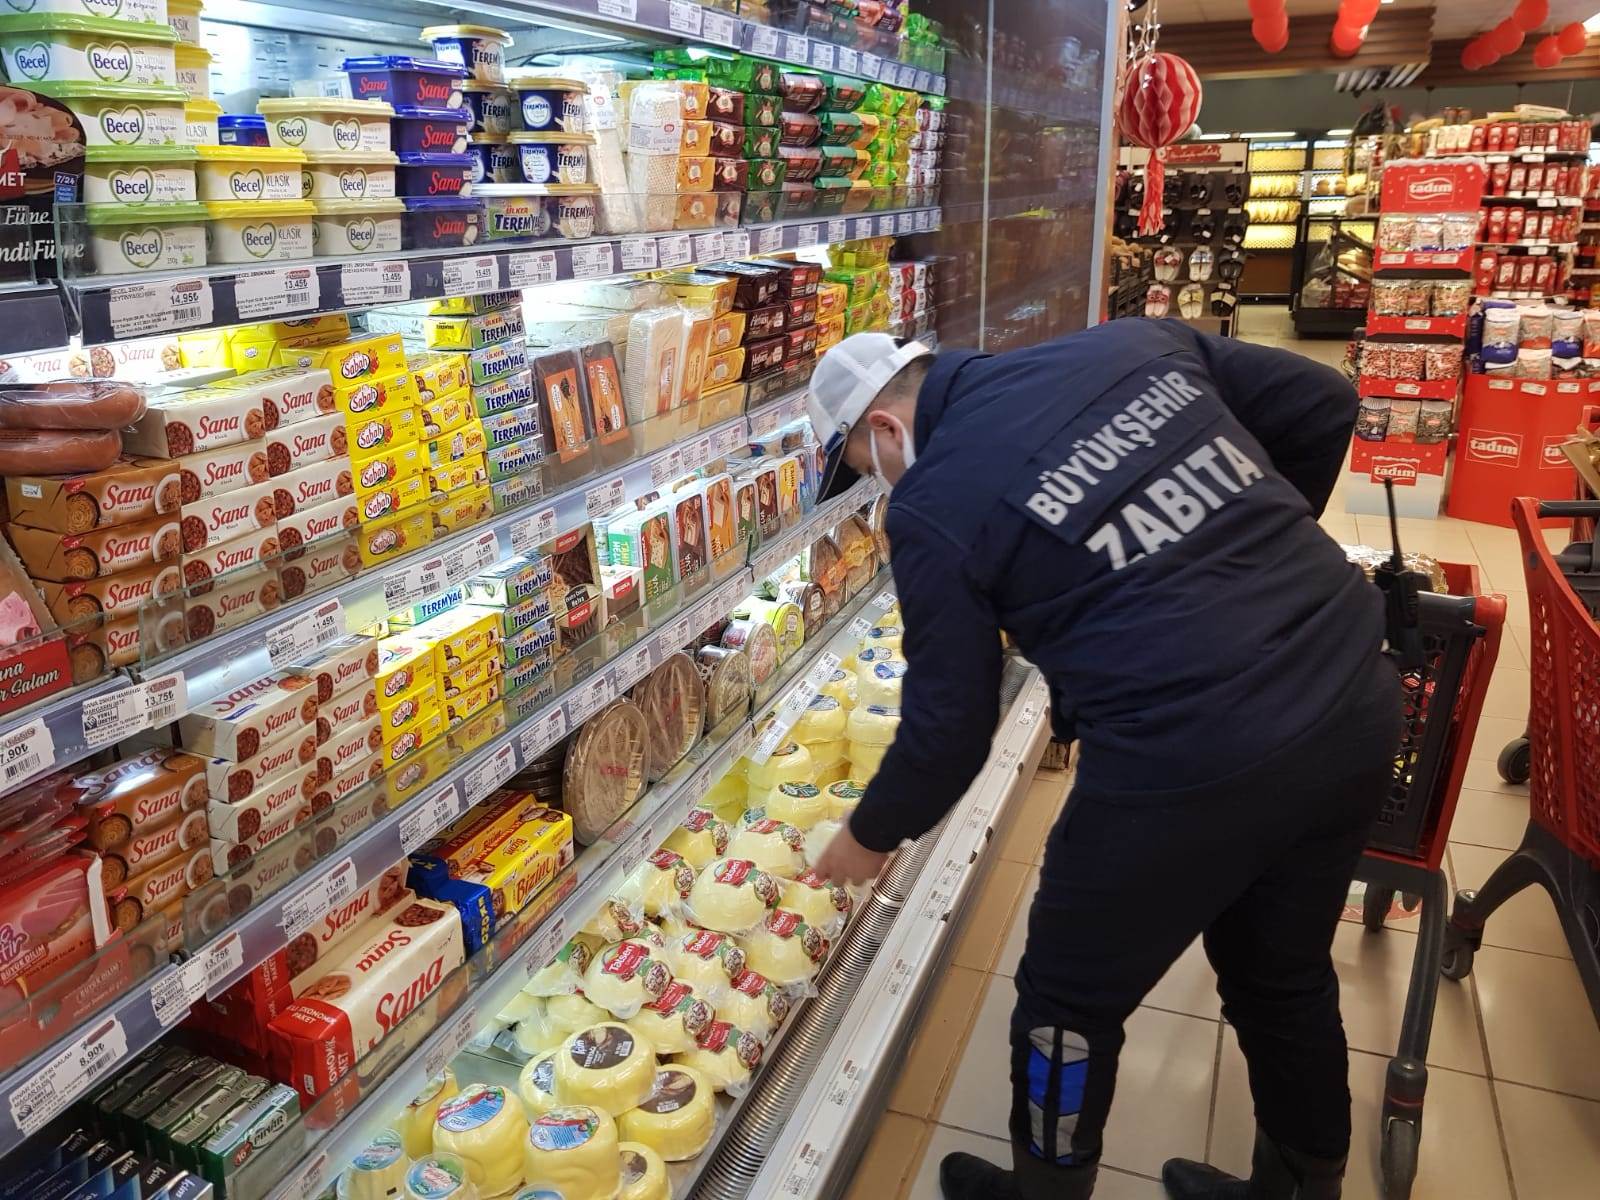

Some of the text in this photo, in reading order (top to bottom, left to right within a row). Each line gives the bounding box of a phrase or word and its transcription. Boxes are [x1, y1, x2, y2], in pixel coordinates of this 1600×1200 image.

[19, 53, 47, 70] Becel
[93, 53, 129, 71] Becel
[359, 77, 388, 93] Sana
[417, 78, 450, 101] Sana
[106, 117, 140, 134] Becel
[280, 126, 304, 138] Becel
[337, 131, 358, 142] Becel
[422, 125, 454, 147] Sana
[57, 175, 75, 184] 7/24
[116, 178, 151, 195] Becel
[234, 178, 261, 193] Becel
[342, 176, 365, 190] Becel
[428, 172, 460, 195] Sana
[1409, 181, 1453, 194] tadım
[5, 207, 49, 225] Füme
[432, 216, 465, 240] Sana
[246, 231, 273, 246] Becel
[350, 227, 373, 241] Becel
[126, 240, 159, 256] Becel
[118, 344, 155, 366] Sana
[342, 354, 370, 378] Sabah
[484, 350, 505, 361] ÜLKER
[351, 389, 378, 413] Sabah
[490, 384, 510, 395] ÜLKER
[281, 390, 313, 414] Sana
[197, 414, 239, 440] Sana
[497, 416, 517, 427] ÜLKER
[293, 433, 326, 458] Sana
[358, 424, 385, 447] Sabah
[1470, 438, 1518, 456] tadım
[503, 448, 523, 459] ÜLKER
[1025, 371, 1203, 525] BÜYÜKŞEHİR
[204, 459, 243, 486] Sana
[362, 458, 388, 481] Sabah
[103, 484, 154, 510] Sana
[298, 479, 331, 503] Sana
[366, 492, 392, 515] Sabah
[1083, 436, 1264, 571] ZABITA
[210, 503, 249, 531] Sana
[305, 514, 338, 540] Sana
[102, 534, 150, 564] Sana
[215, 546, 253, 574] Sana
[308, 553, 339, 579] Sana
[105, 578, 152, 609] Sana
[217, 588, 255, 618] Sana
[107, 629, 140, 656] San
[335, 657, 363, 684] Sana
[11, 672, 60, 699] Salam
[213, 678, 278, 712] Sana
[144, 689, 174, 710] 13,75₺
[262, 706, 297, 737] Sana
[331, 700, 360, 726] Sana
[256, 747, 294, 779] Sana
[334, 736, 363, 766] Sana
[334, 770, 364, 800] Sana
[135, 790, 180, 825] Sana
[263, 783, 297, 816] Sana
[130, 828, 177, 864] Sana
[254, 820, 289, 851] Sana
[145, 867, 184, 904] Sana
[254, 856, 289, 891] Sana
[517, 857, 554, 906] Bizim
[322, 889, 370, 942] Sana
[356, 930, 411, 973] Sana
[375, 956, 445, 1036] Sana
[79, 1042, 106, 1067] 8,90₺
